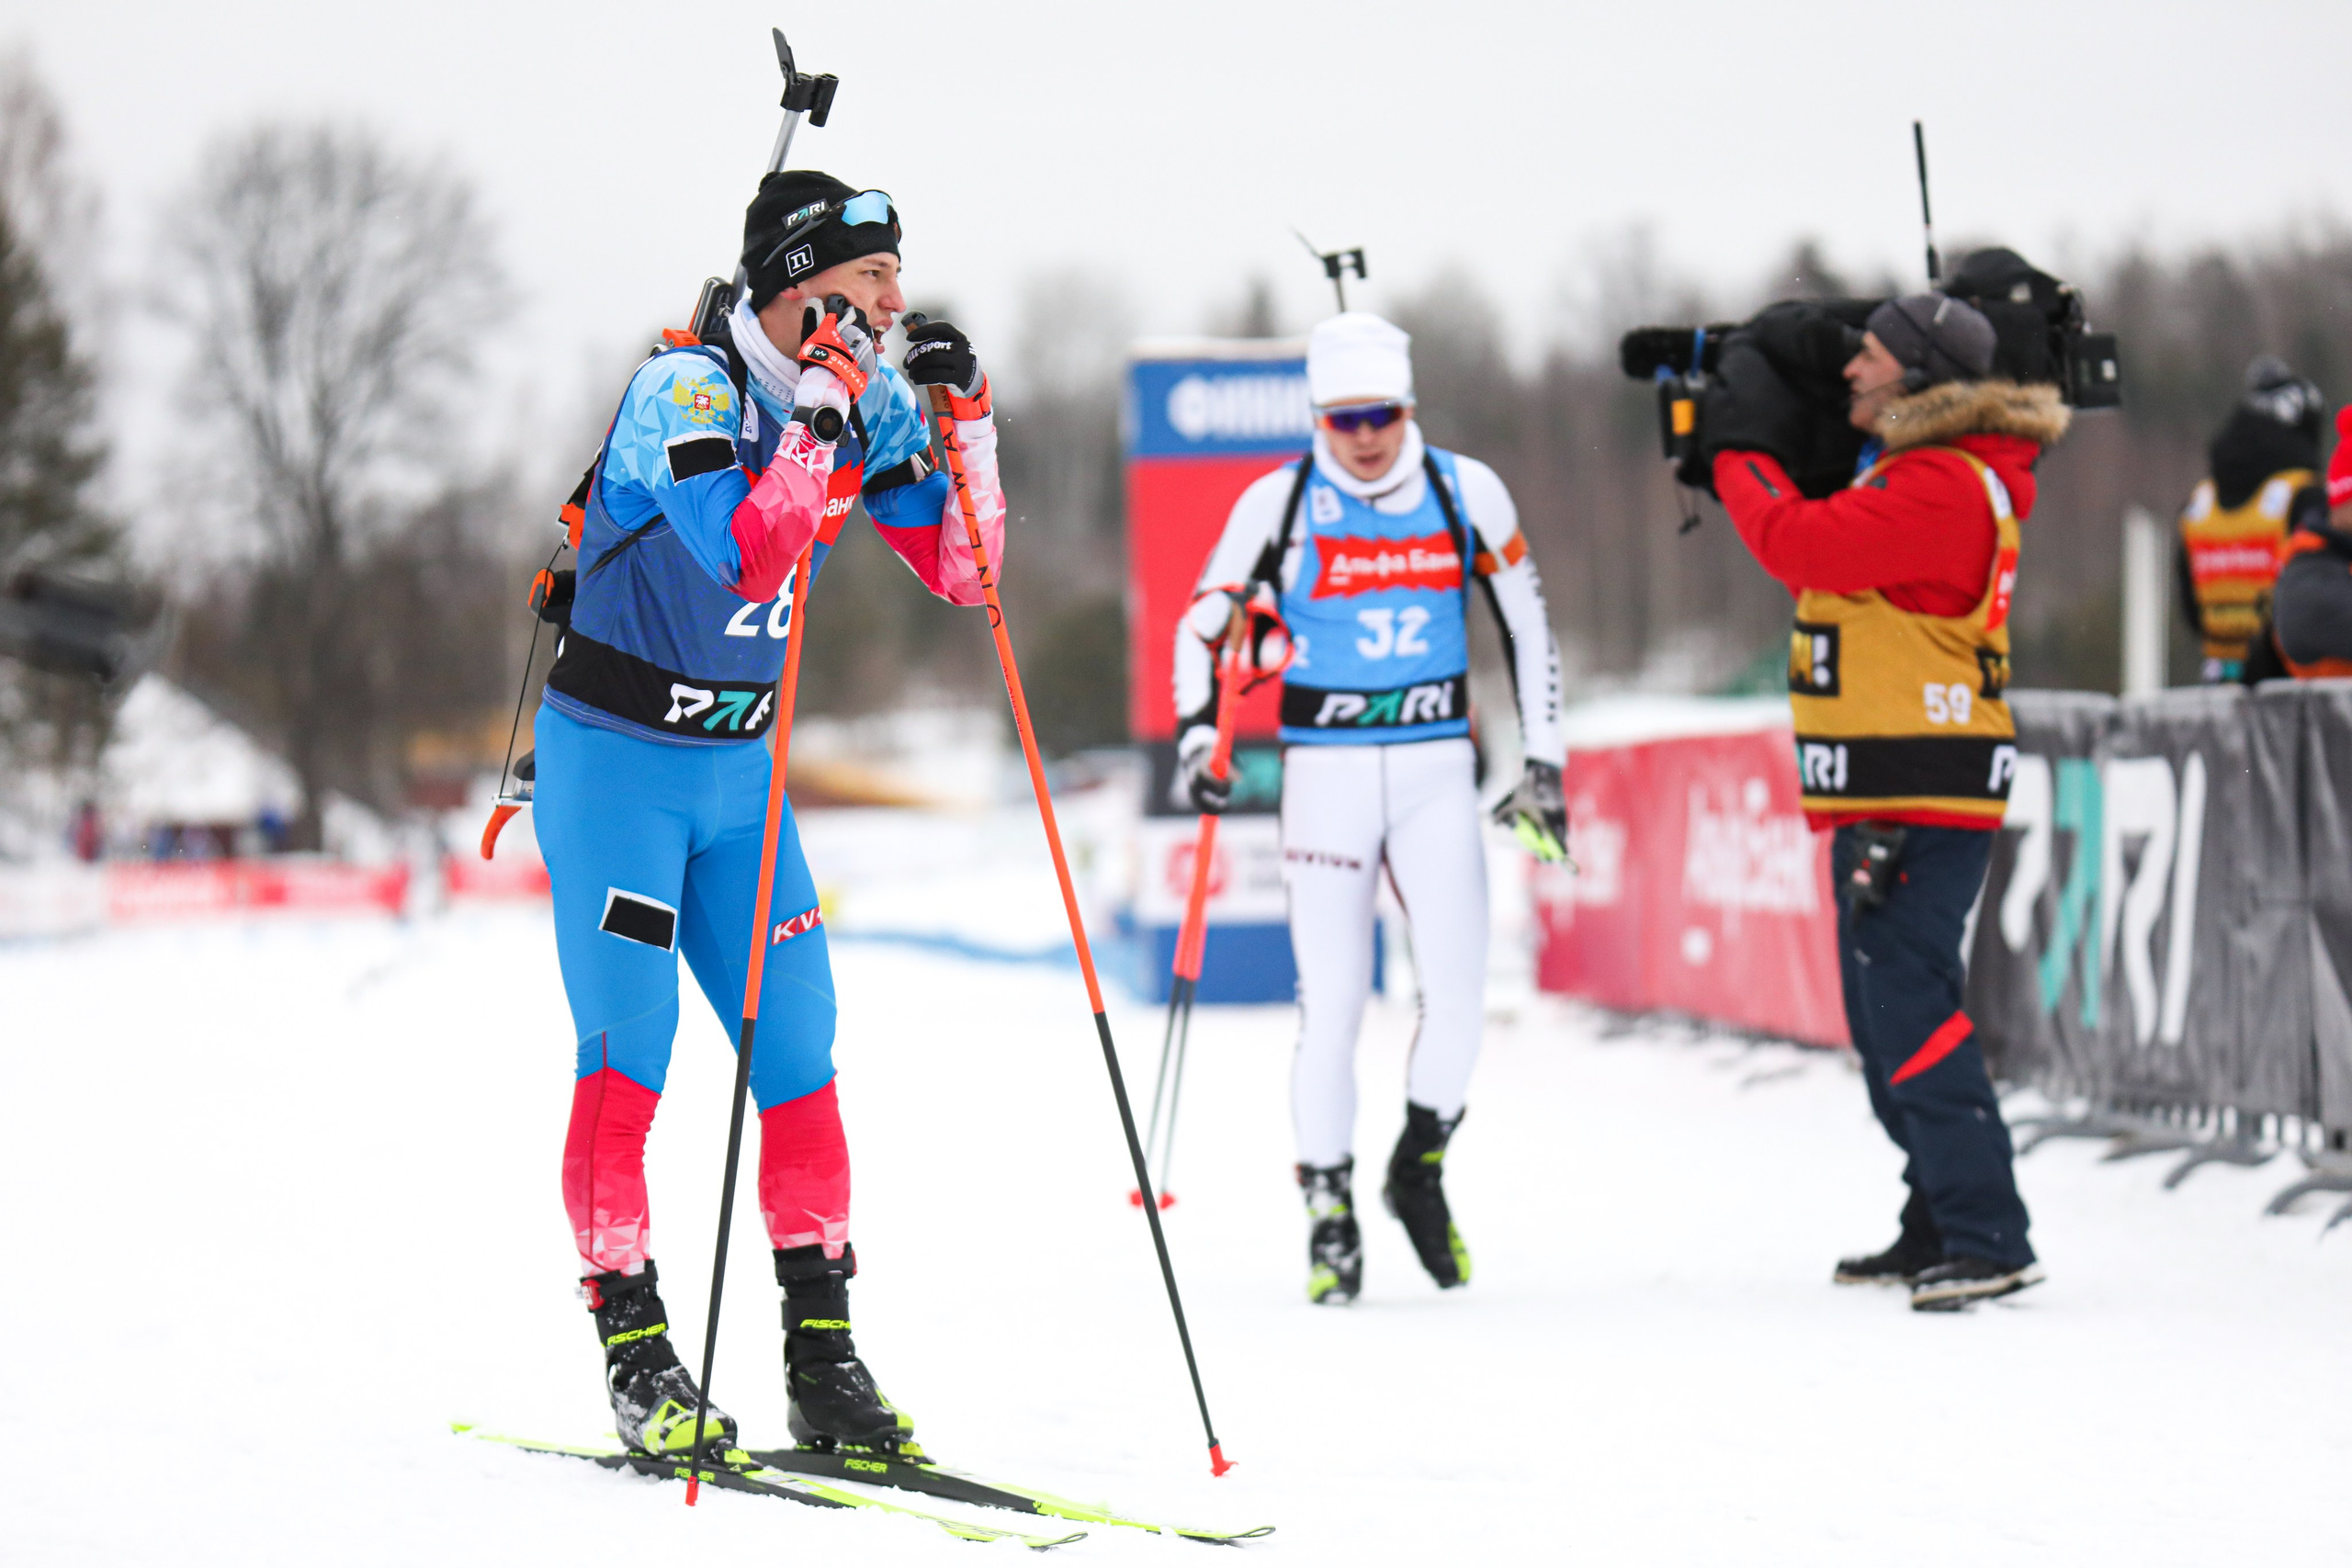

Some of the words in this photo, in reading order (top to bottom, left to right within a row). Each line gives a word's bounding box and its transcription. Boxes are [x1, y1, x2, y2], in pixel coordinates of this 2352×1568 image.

[786, 201, 825, 226] PARI
[822, 493, 857, 517] анк
[724, 563, 797, 639] 28
[1355, 605, 1430, 660] 32
[1315, 682, 1455, 726] PARI
[1923, 682, 1973, 724] 59
[1797, 743, 1849, 791] RI
[606, 1323, 667, 1346] FISCHER
[843, 1459, 888, 1473] FISCHER
